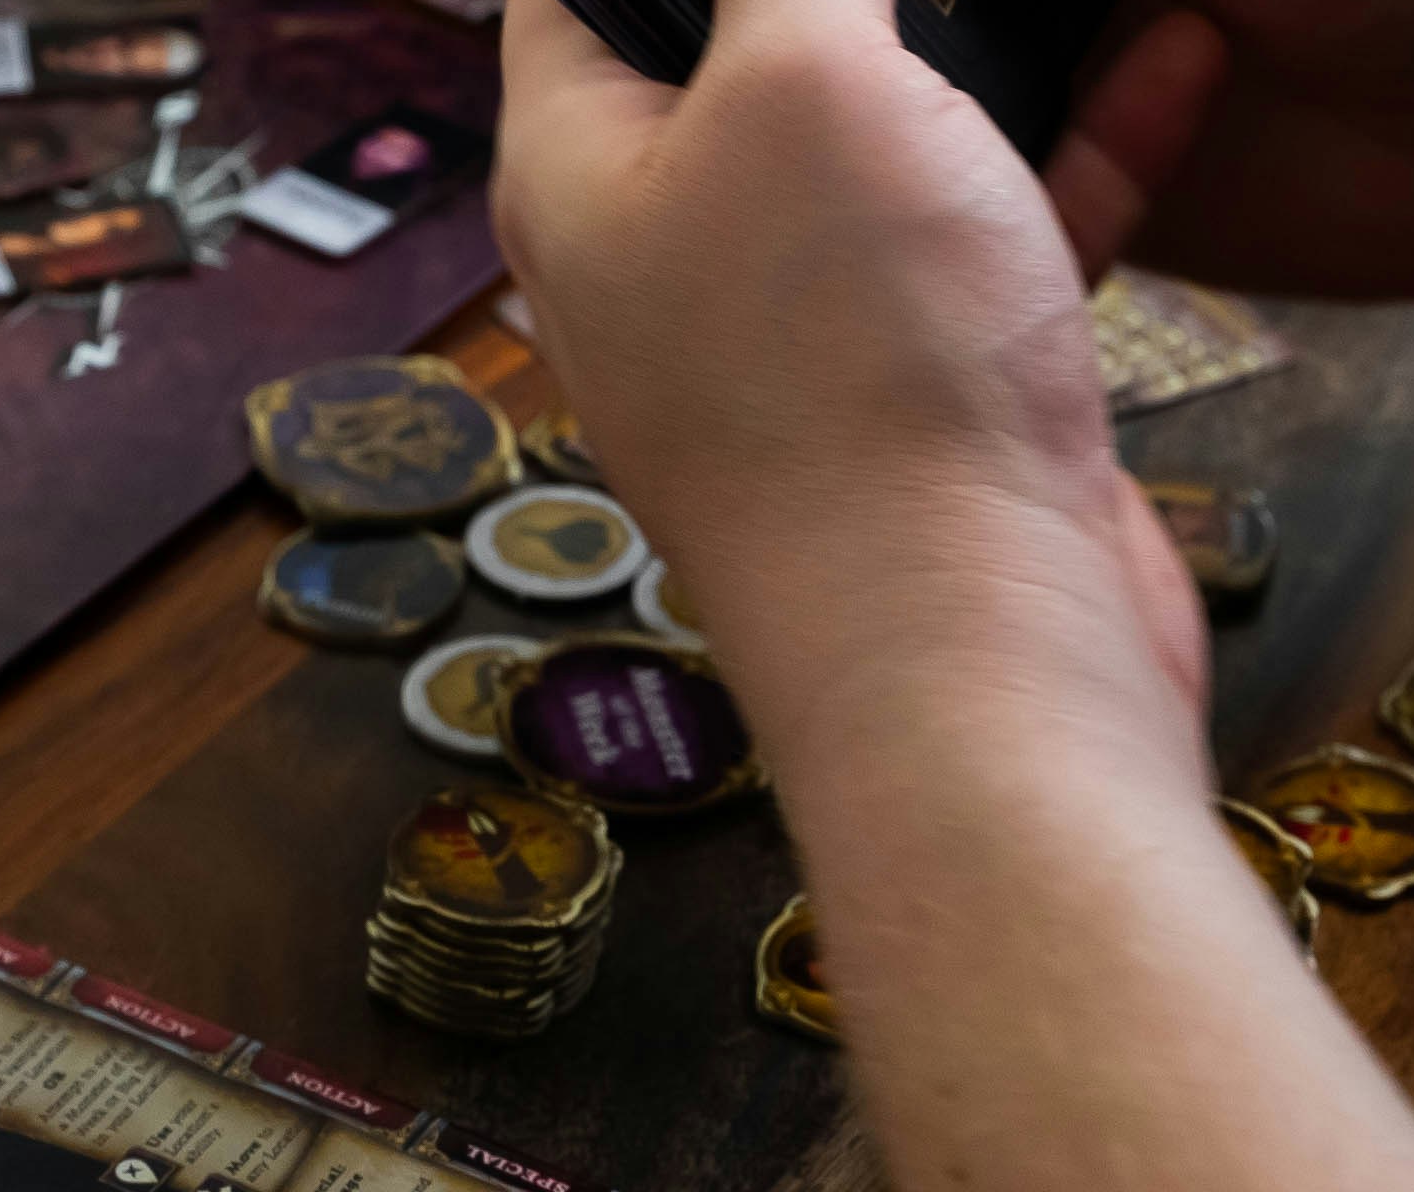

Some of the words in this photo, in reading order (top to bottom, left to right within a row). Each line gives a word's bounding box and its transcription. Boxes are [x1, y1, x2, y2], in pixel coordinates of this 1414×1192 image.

[102, 993, 197, 1039] ACTION
[287, 1069, 383, 1116] ACTION
[466, 1143, 571, 1192] SPECIAL
